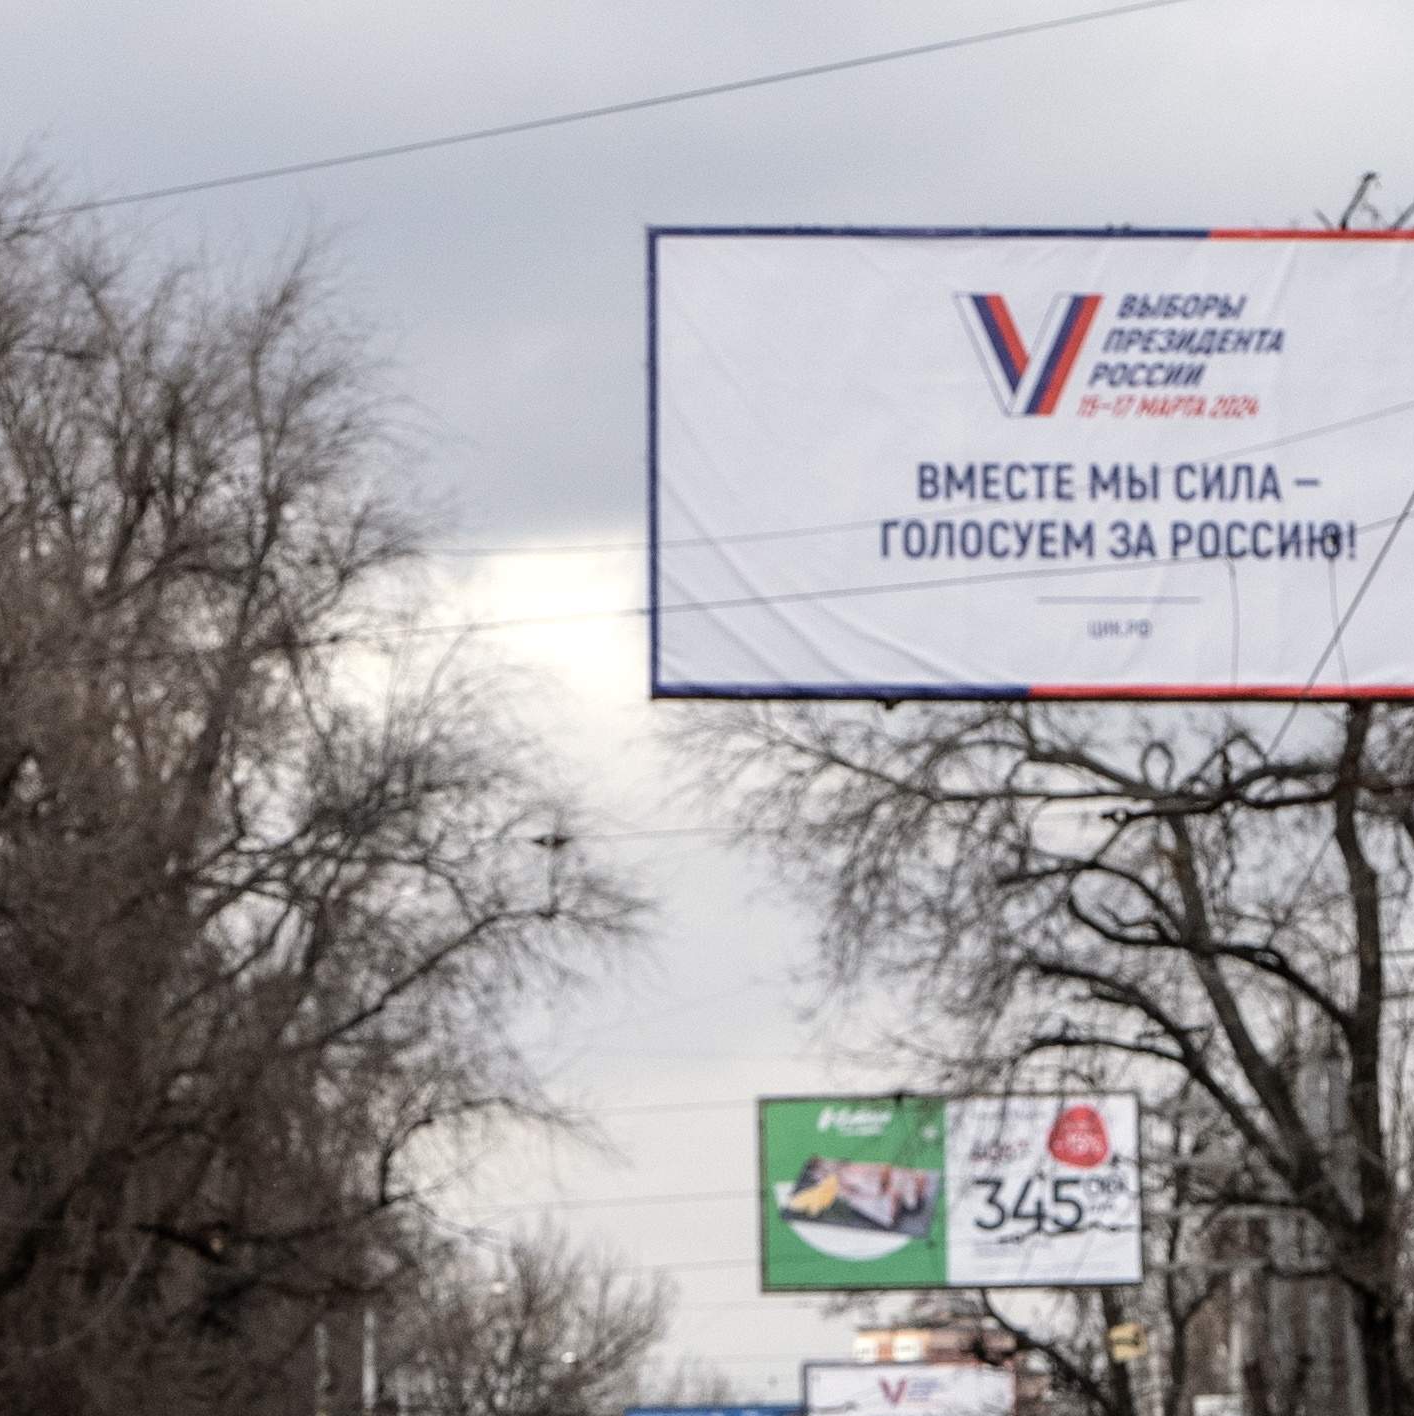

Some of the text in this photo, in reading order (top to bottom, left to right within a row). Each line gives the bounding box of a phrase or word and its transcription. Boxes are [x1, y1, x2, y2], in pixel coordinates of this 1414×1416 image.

[1116, 293, 1246, 320] ВЫБОРЫ
[1101, 327, 1285, 357] ПРЕЗИДЕНТА
[1087, 362, 1207, 388] РОССИИ
[1136, 395, 1206, 418] МАРТА
[1209, 395, 1260, 420] 2024
[916, 462, 1076, 502] ВМЕСТЕ
[1088, 462, 1161, 502] МЫ
[1173, 462, 1283, 502] СИЛА
[880, 519, 1358, 560] ГОЛОСУЕМ ЗА РОССИЮ!
[973, 1177, 1083, 1232] 345
